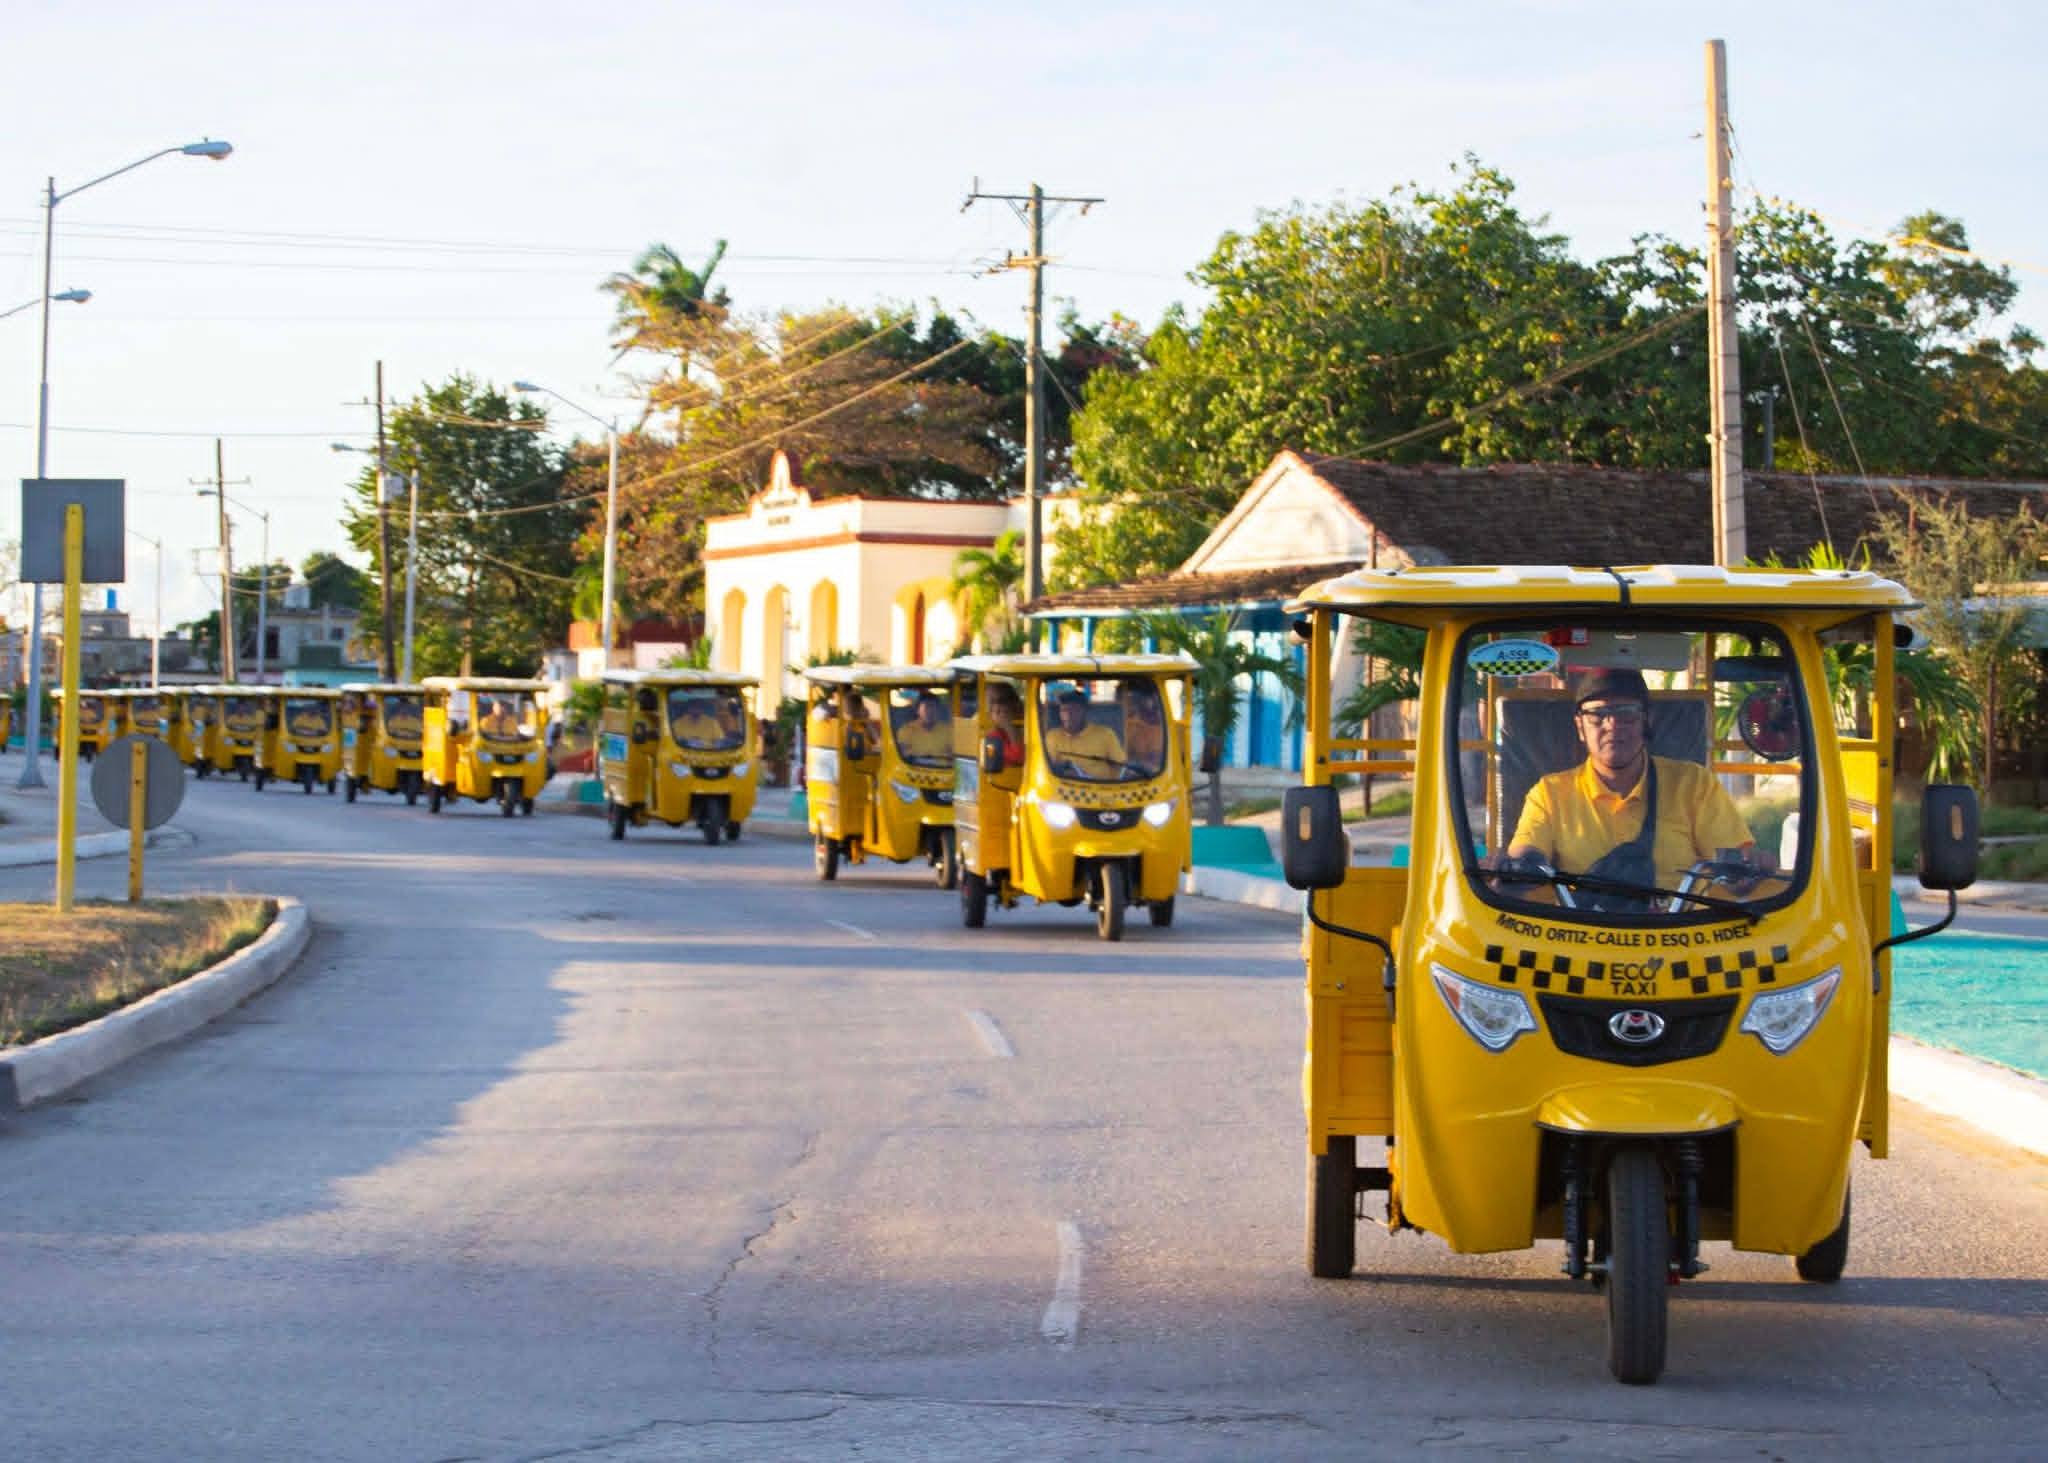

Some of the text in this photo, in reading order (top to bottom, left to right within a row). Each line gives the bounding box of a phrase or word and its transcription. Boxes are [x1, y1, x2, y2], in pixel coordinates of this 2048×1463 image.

[1497, 913, 1542, 937] MICRO
[1645, 933, 1657, 947] D
[1661, 933, 1690, 948] ESQ
[1713, 923, 1751, 943] HDEZ
[1610, 962, 1657, 981] ECO
[1610, 982, 1657, 996] TAXI
